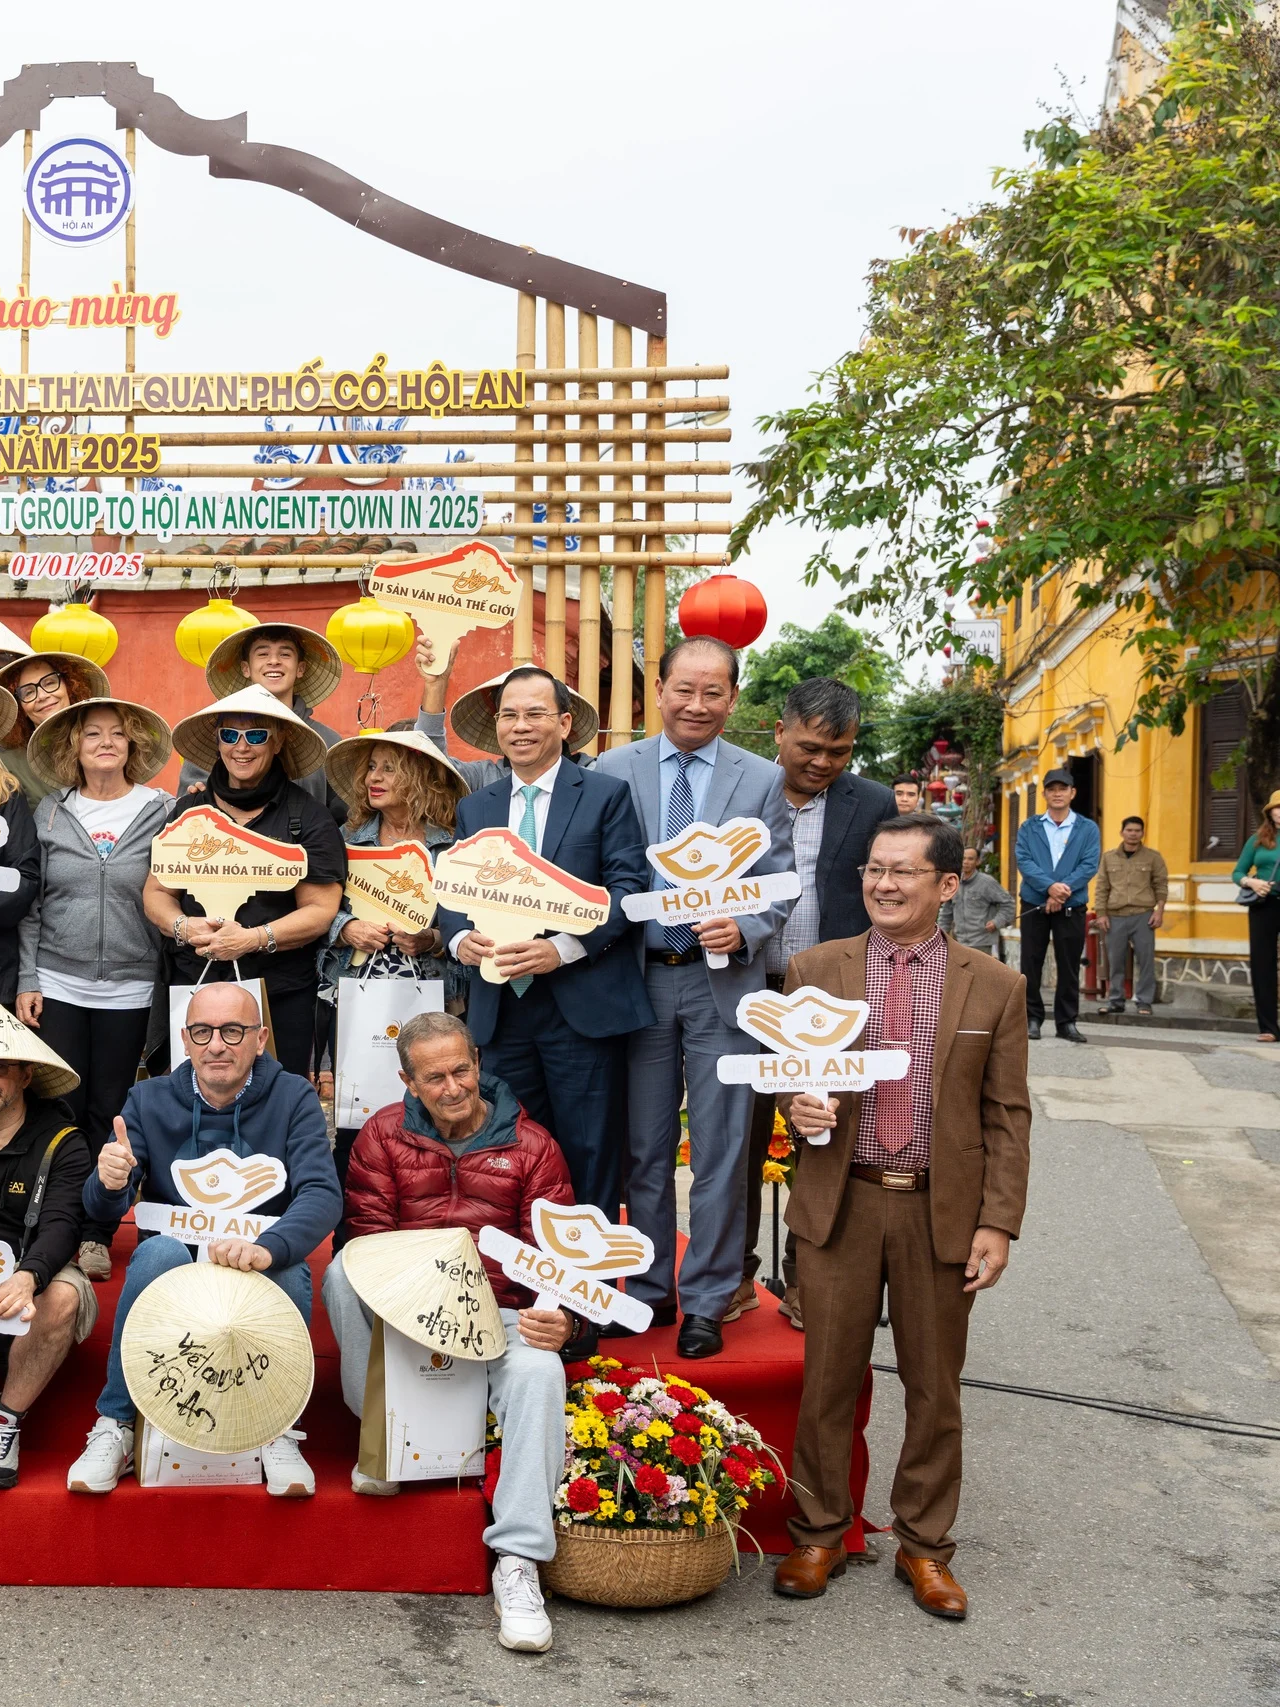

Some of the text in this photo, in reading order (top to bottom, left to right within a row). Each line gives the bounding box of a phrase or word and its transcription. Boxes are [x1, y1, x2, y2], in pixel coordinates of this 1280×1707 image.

[63, 221, 78, 230] HỘI
[70, 284, 178, 336] mừng
[39, 376, 130, 408] THAM
[144, 376, 236, 409] QUAN
[251, 360, 320, 408] PHỐ
[334, 355, 386, 407] CỔ
[401, 364, 459, 417] HỘI
[475, 371, 523, 405] AN
[82, 436, 158, 470] 2025
[20, 496, 99, 529] GROUP
[106, 496, 135, 529] TO
[142, 494, 179, 537] HỘI
[186, 496, 215, 529] AN
[222, 496, 320, 529] ANCIENT
[327, 496, 392, 529] TOWN
[401, 496, 420, 528] IN
[429, 495, 478, 529] 2025
[12, 554, 141, 577] 01/01/2025
[485, 576, 511, 594] An
[372, 581, 515, 616] DI SẢN VĂN HÓA THẾ GIỚI
[980, 630, 994, 638] AN
[221, 838, 248, 855] An
[153, 862, 302, 876] DI SẢN VĂN HÓA THẾ GIỚI
[516, 868, 546, 887] An
[354, 876, 371, 893] VĂN
[371, 887, 389, 905] HÓA
[391, 899, 410, 915] THẾ
[408, 910, 428, 927] GIỚI
[412, 883, 429, 904] An
[434, 880, 604, 921] DI SẢN VĂN HÓA THẾ GIỚI
[662, 883, 761, 913] HỘI AN
[692, 910, 715, 918] CRAFTS
[759, 1055, 864, 1081] HỘI AN
[34, 1185, 42, 1203] Nikon
[170, 1210, 261, 1237] HỘI AN
[514, 1248, 613, 1310] HỘI AN
